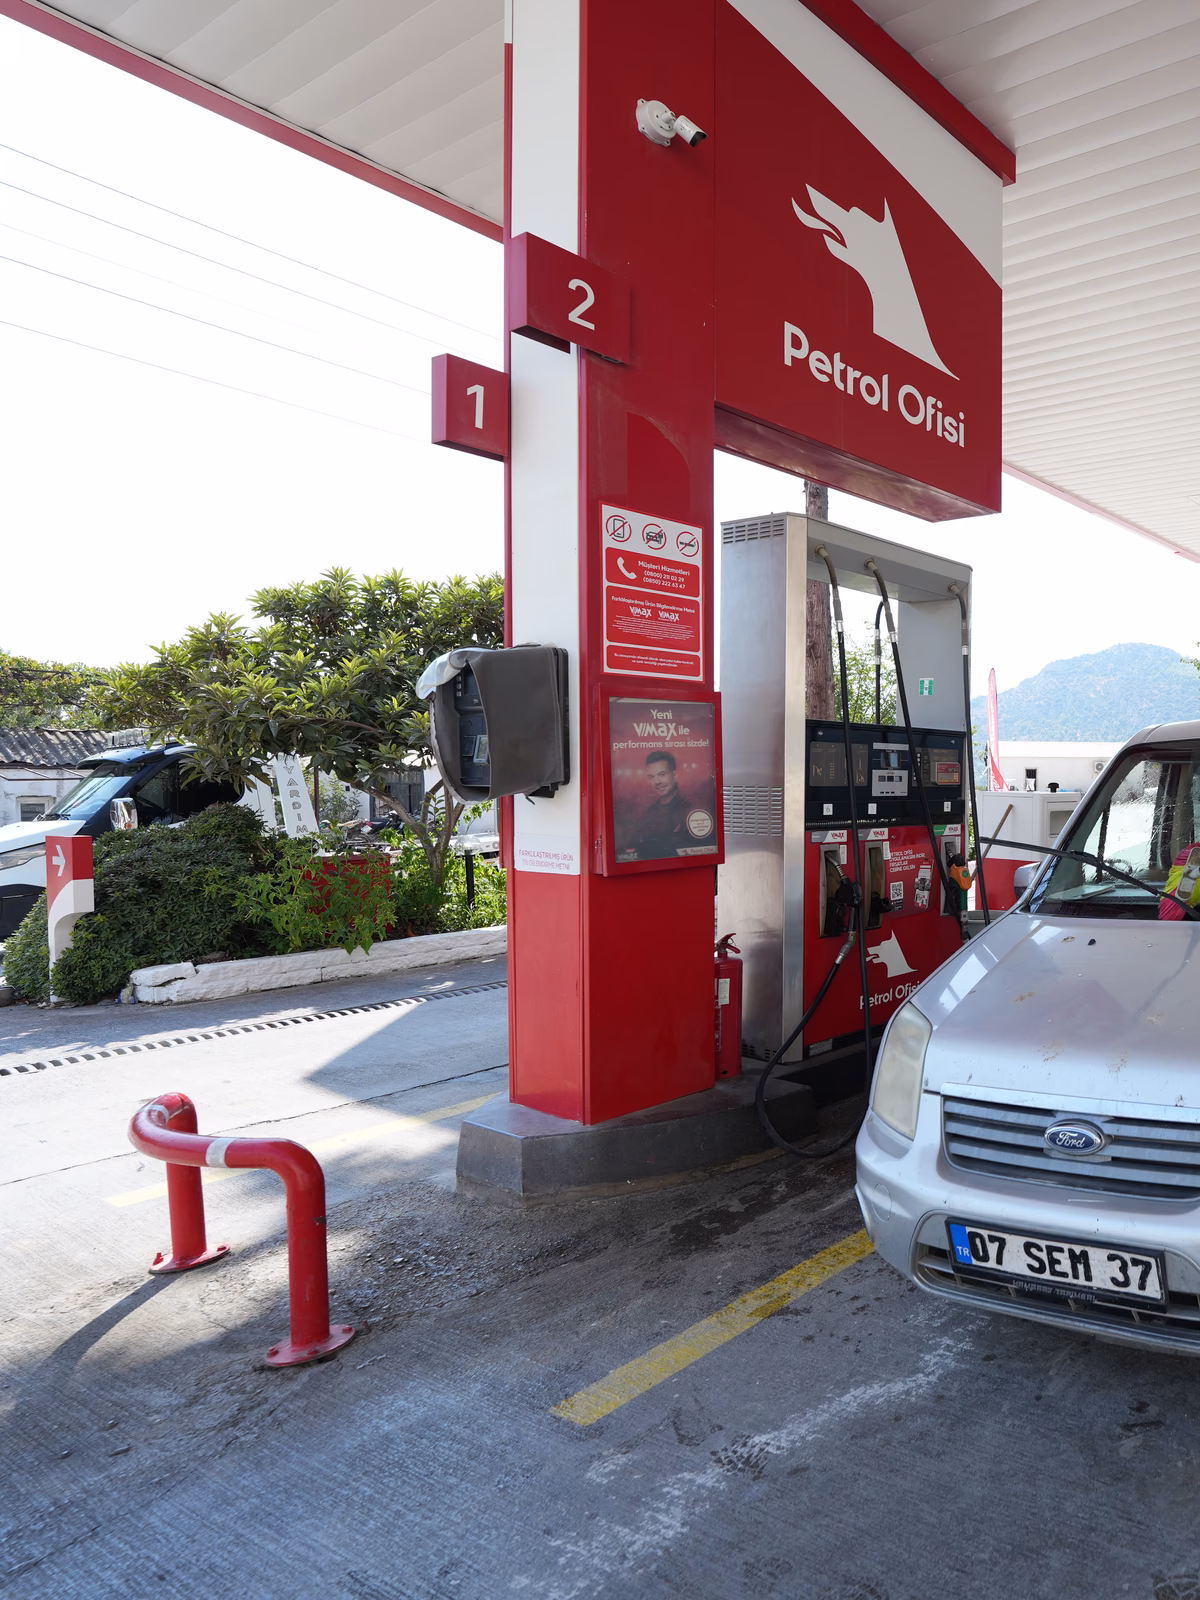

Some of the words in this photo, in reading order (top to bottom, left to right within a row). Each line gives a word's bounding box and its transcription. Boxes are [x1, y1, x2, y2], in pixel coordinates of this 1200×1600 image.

[568, 278, 595, 331] 2
[784, 321, 888, 412] Petrol
[898, 384, 964, 448] Ofisi
[467, 384, 484, 430] 1
[638, 560, 660, 570] Müşteri
[662, 565, 690, 576] Hizmetleri
[644, 570, 662, 579] (0800)
[650, 709, 672, 719] Yeni
[678, 725, 690, 735] ile
[613, 740, 663, 751] performans
[283, 766, 308, 833] YARDIM
[1056, 1132, 1085, 1148] Ford
[957, 1246, 970, 1257] TR
[968, 1231, 1006, 1266] 07
[1023, 1241, 1093, 1282] SEM
[1107, 1254, 1153, 1292] 37
